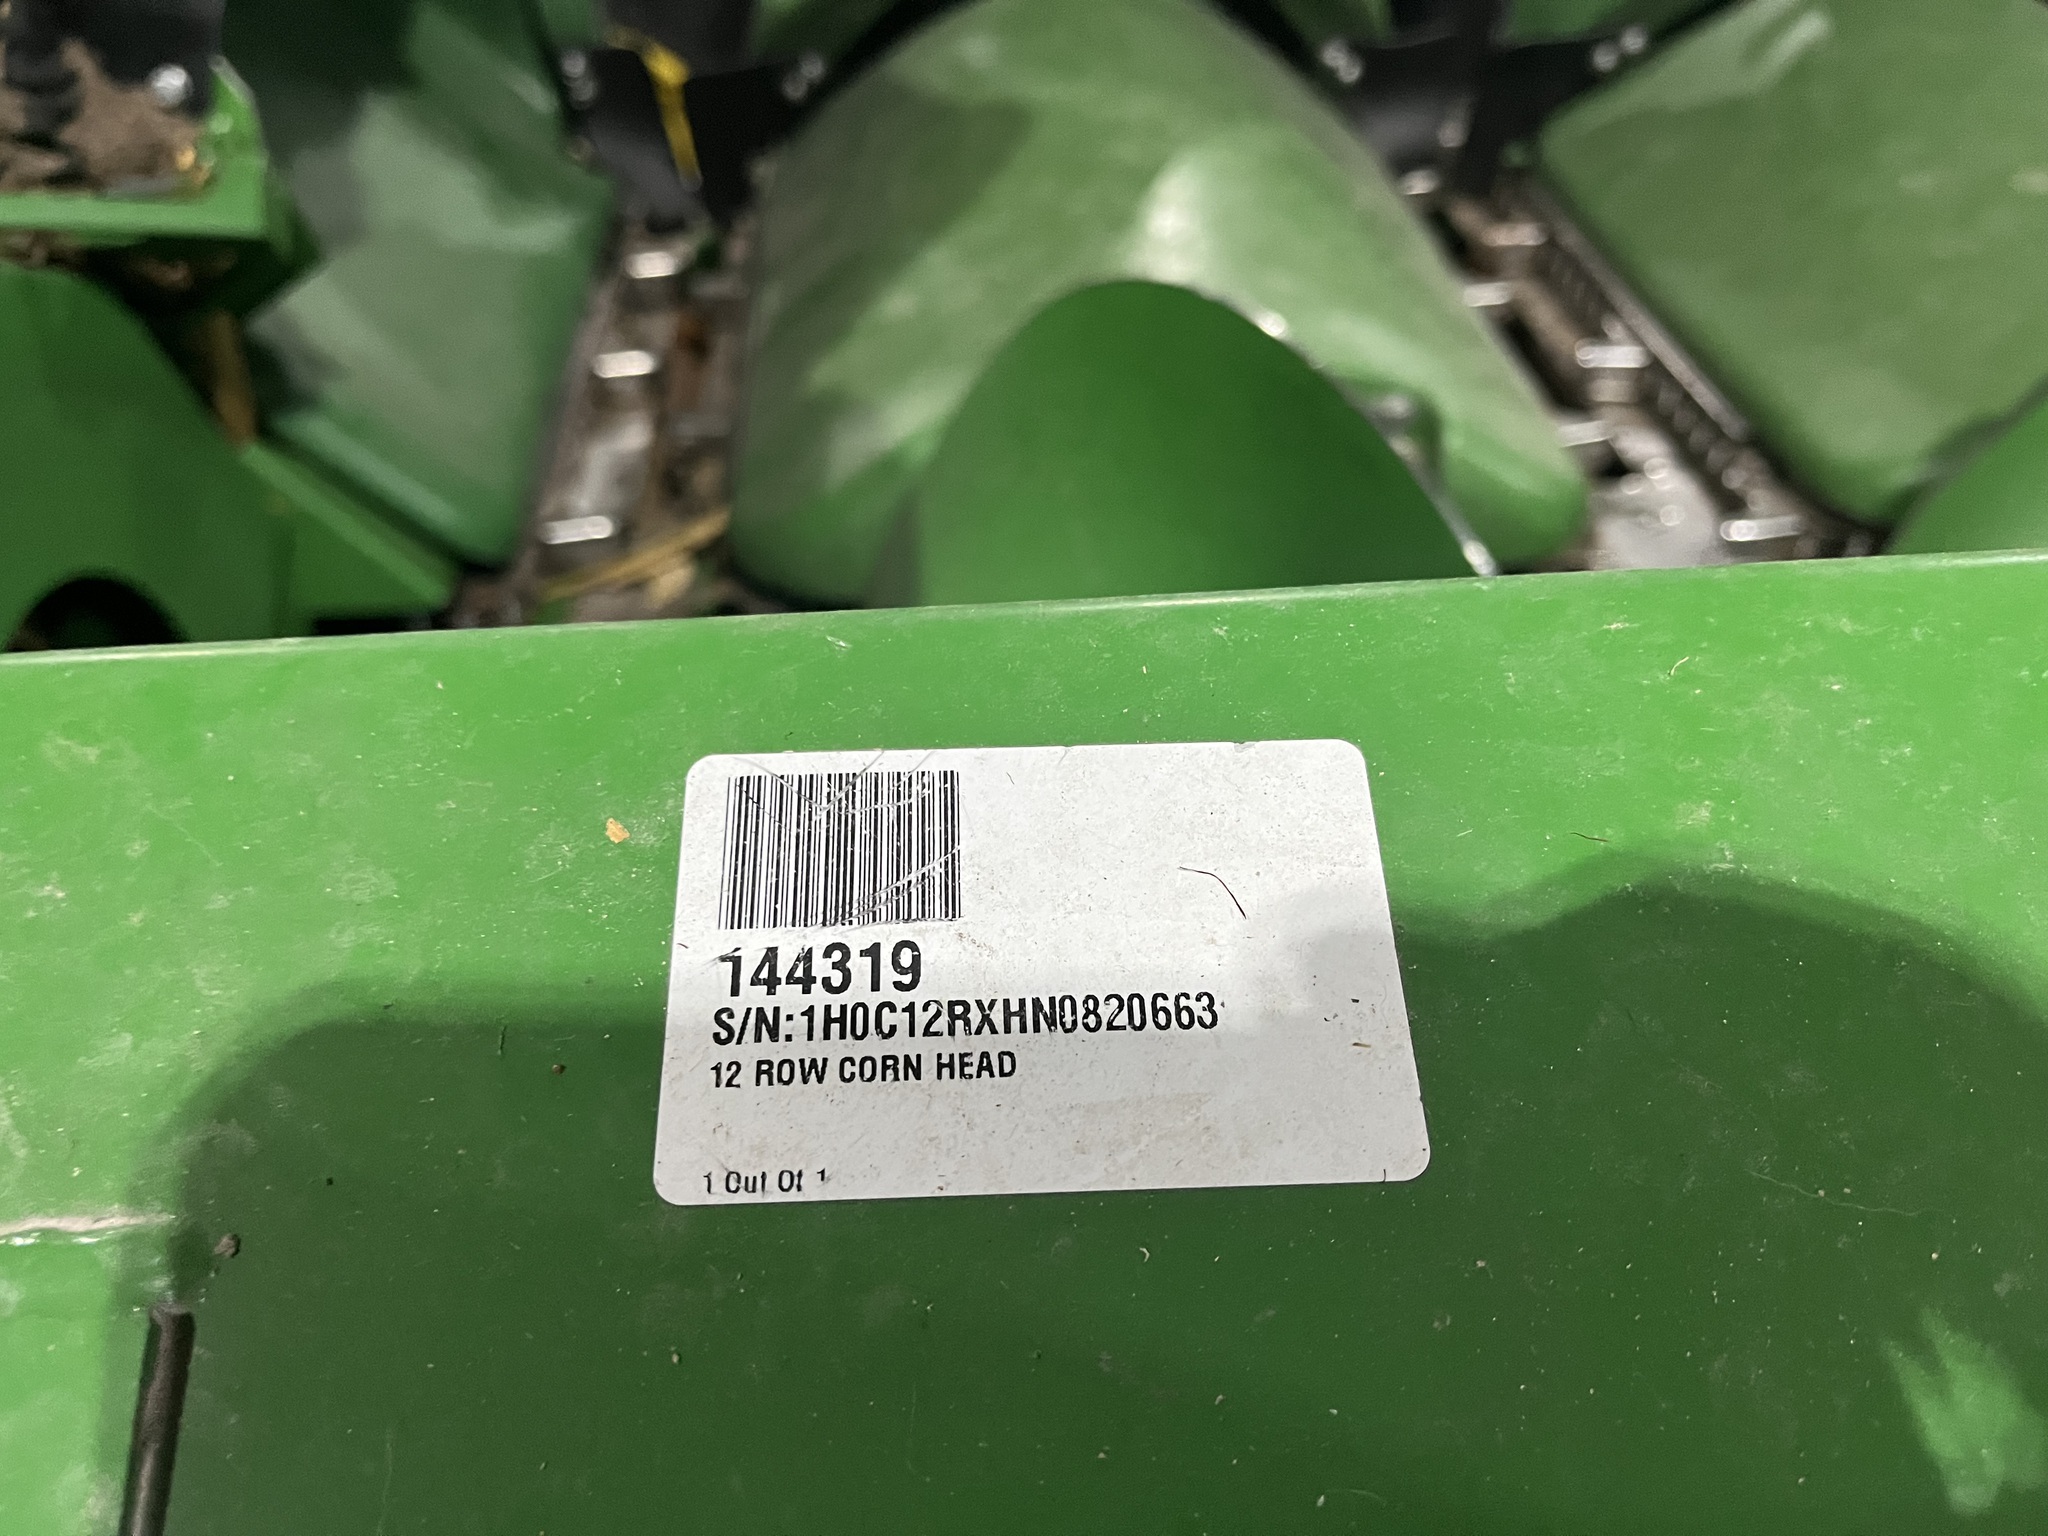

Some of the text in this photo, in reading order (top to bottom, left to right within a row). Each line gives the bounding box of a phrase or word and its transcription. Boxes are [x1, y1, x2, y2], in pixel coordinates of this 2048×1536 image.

[720, 940, 922, 998] 144319
[710, 1050, 1018, 1089] 12 ROW CORN HEAD
[703, 1171, 712, 1194] 1
